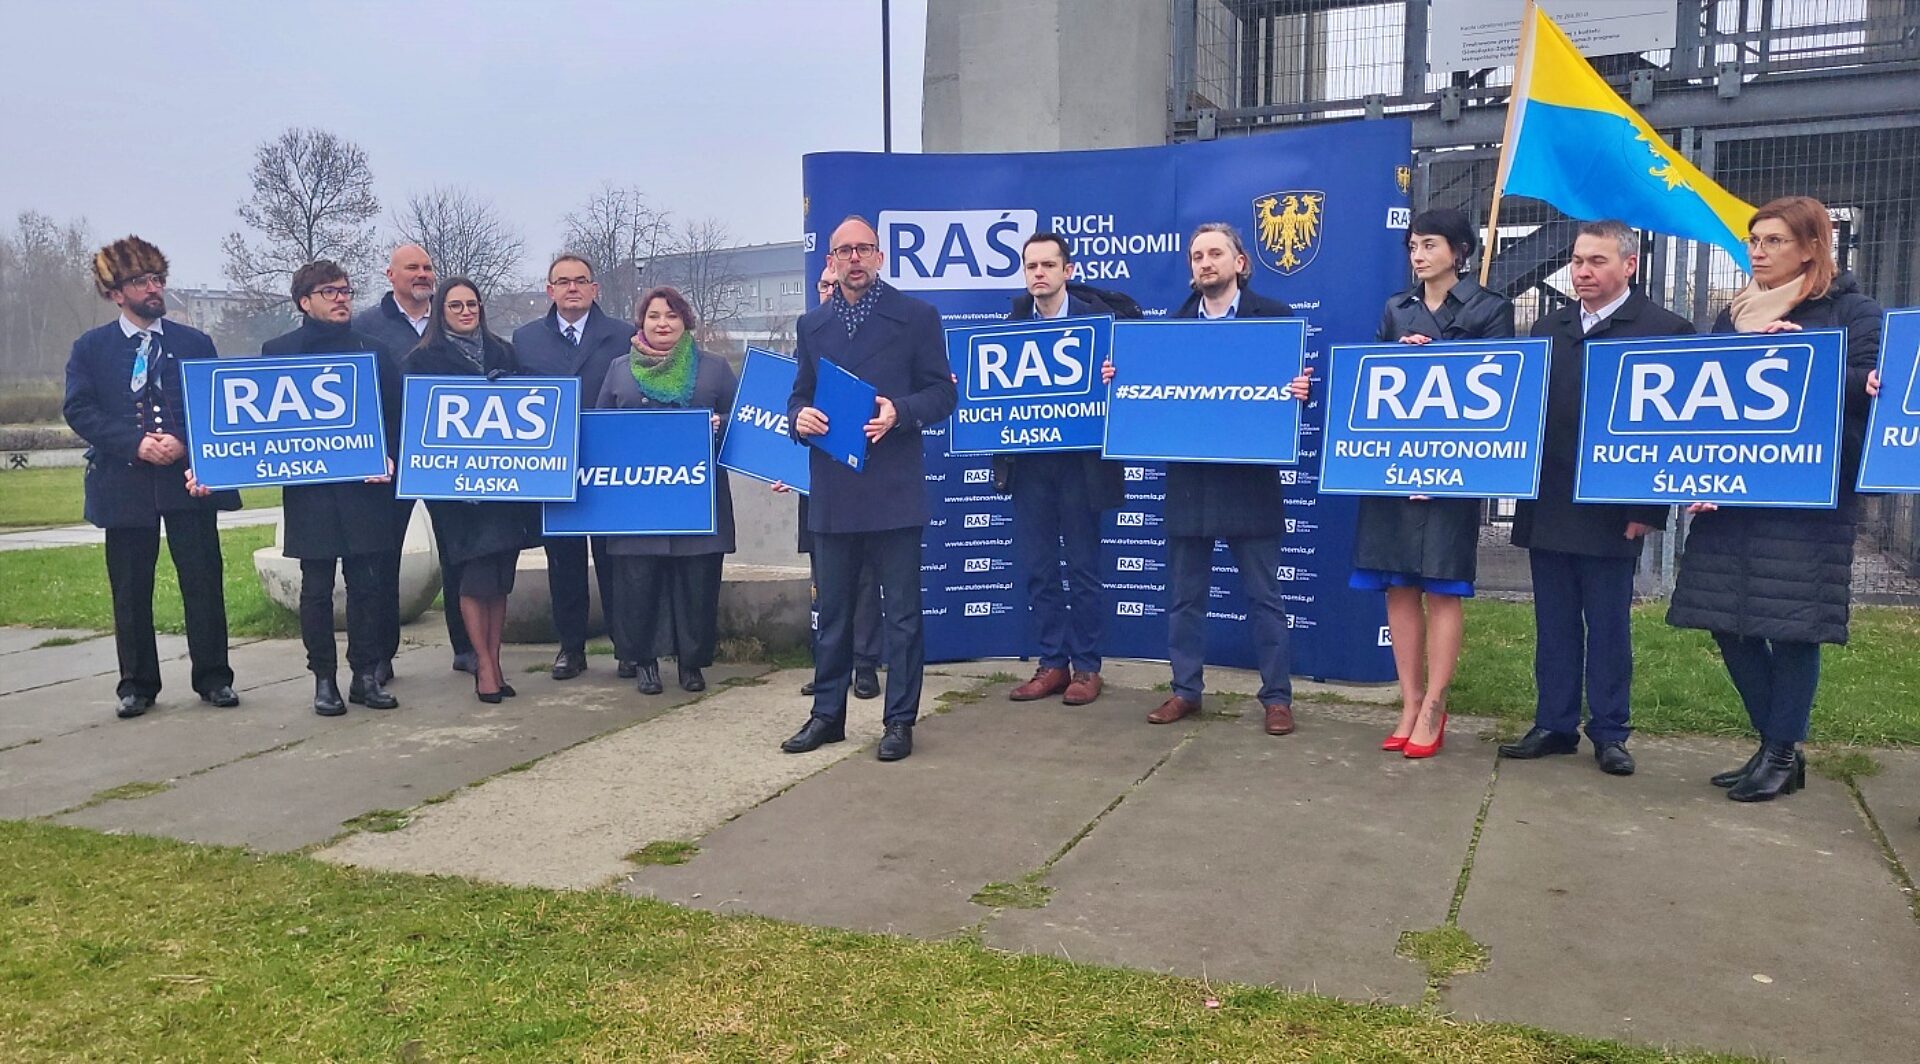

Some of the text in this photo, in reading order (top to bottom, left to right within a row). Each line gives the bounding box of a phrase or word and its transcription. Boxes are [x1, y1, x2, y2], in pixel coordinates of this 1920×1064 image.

[1051, 214, 1114, 234] RUCH
[1391, 210, 1408, 226] RA
[889, 212, 1022, 278] RAŚ
[1064, 233, 1181, 257] UTONOMII
[1071, 260, 1130, 283] ĄSKA
[978, 330, 1083, 390] RAŚ
[223, 367, 347, 425] RAŚ
[1116, 382, 1292, 401] #SZAFNYMYTOZAŚ
[1366, 355, 1503, 421] RAŚ
[1628, 348, 1790, 422] RAŚ
[437, 388, 547, 440] RAŚ
[737, 404, 790, 437] #WE
[959, 401, 1106, 423] RUCH AUTONOMII
[202, 434, 375, 459] RUCH AUTONOMII
[1000, 426, 1062, 446] ŚLĄSKA
[1882, 426, 1920, 447] RU
[1335, 440, 1391, 459] RUCH
[1398, 441, 1528, 459] AUTONOMII
[1592, 443, 1823, 464] RUCH AUTONOMII
[256, 460, 328, 479] ŚLĄSKA
[410, 455, 567, 471] RUCH AUTONOMII
[577, 461, 707, 486] WELUJRAŚ
[454, 473, 520, 494] ŚLĄSKA
[1384, 463, 1464, 488] ŚLĄSKA
[1652, 469, 1748, 496] ŚLĄSKA
